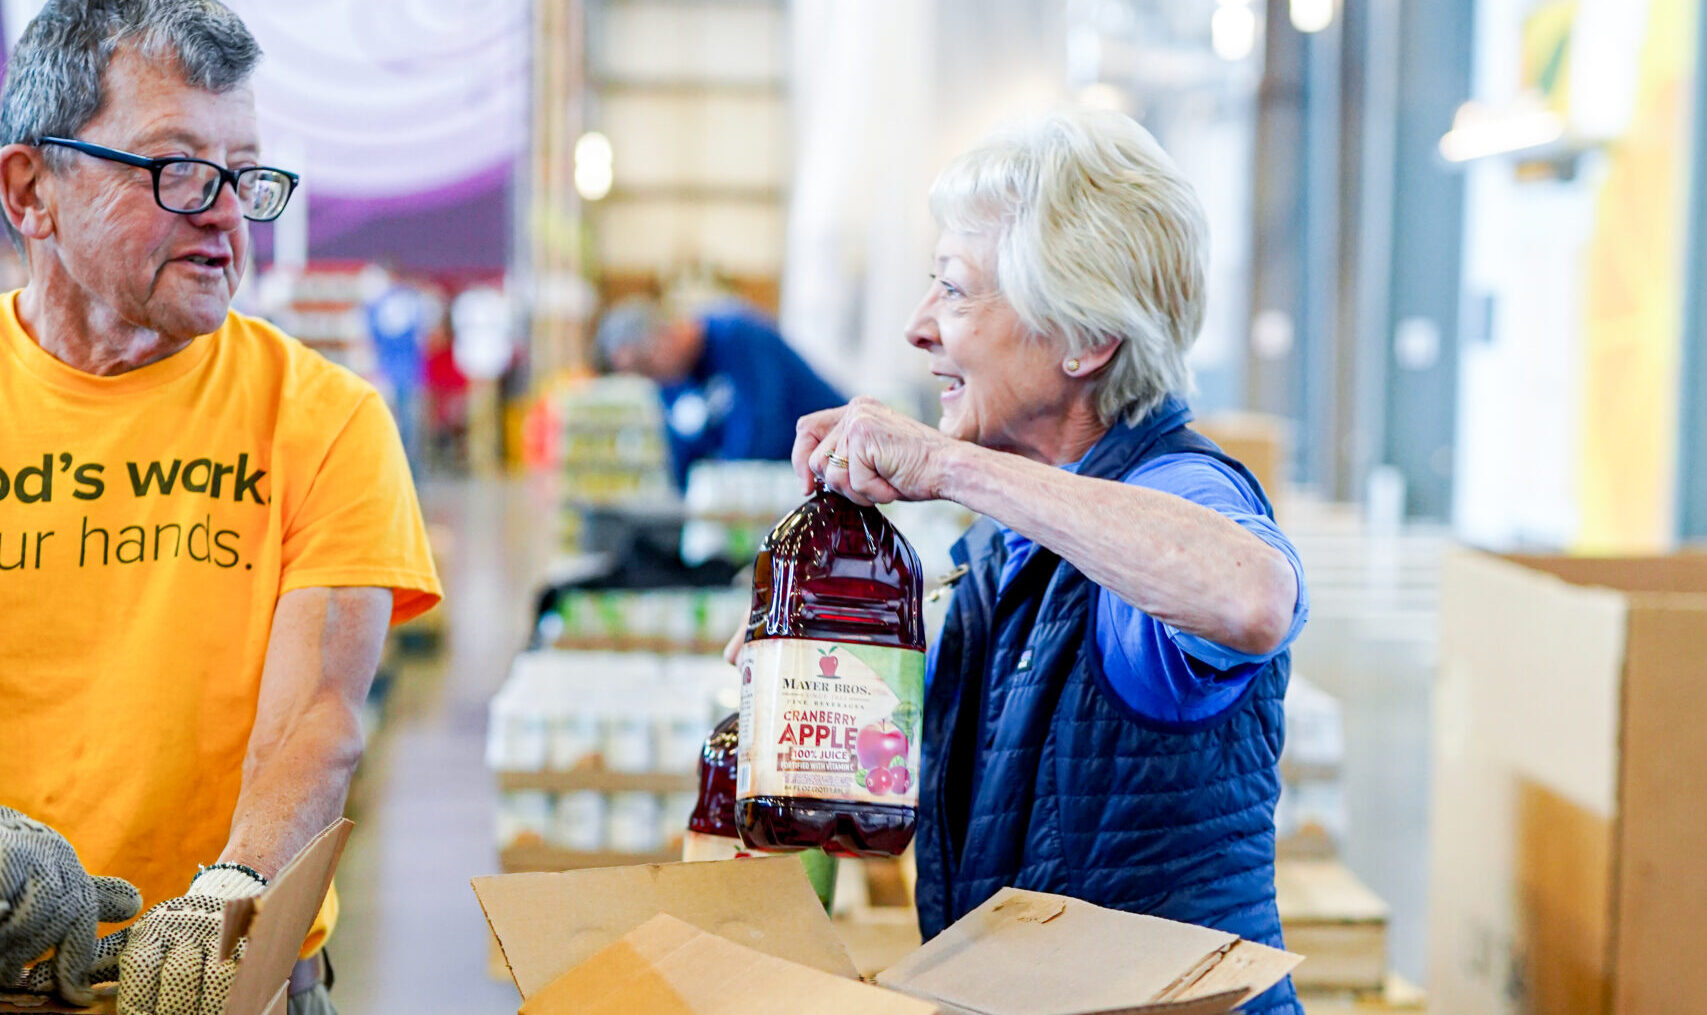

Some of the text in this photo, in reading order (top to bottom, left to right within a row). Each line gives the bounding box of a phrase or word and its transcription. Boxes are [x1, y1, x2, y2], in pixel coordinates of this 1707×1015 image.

[79, 513, 253, 570] hands.
[782, 678, 872, 696] MAYER BROS.
[783, 710, 857, 726] CRANBERRY
[778, 723, 858, 750] APPLE
[794, 749, 848, 760] 100% JUICE
